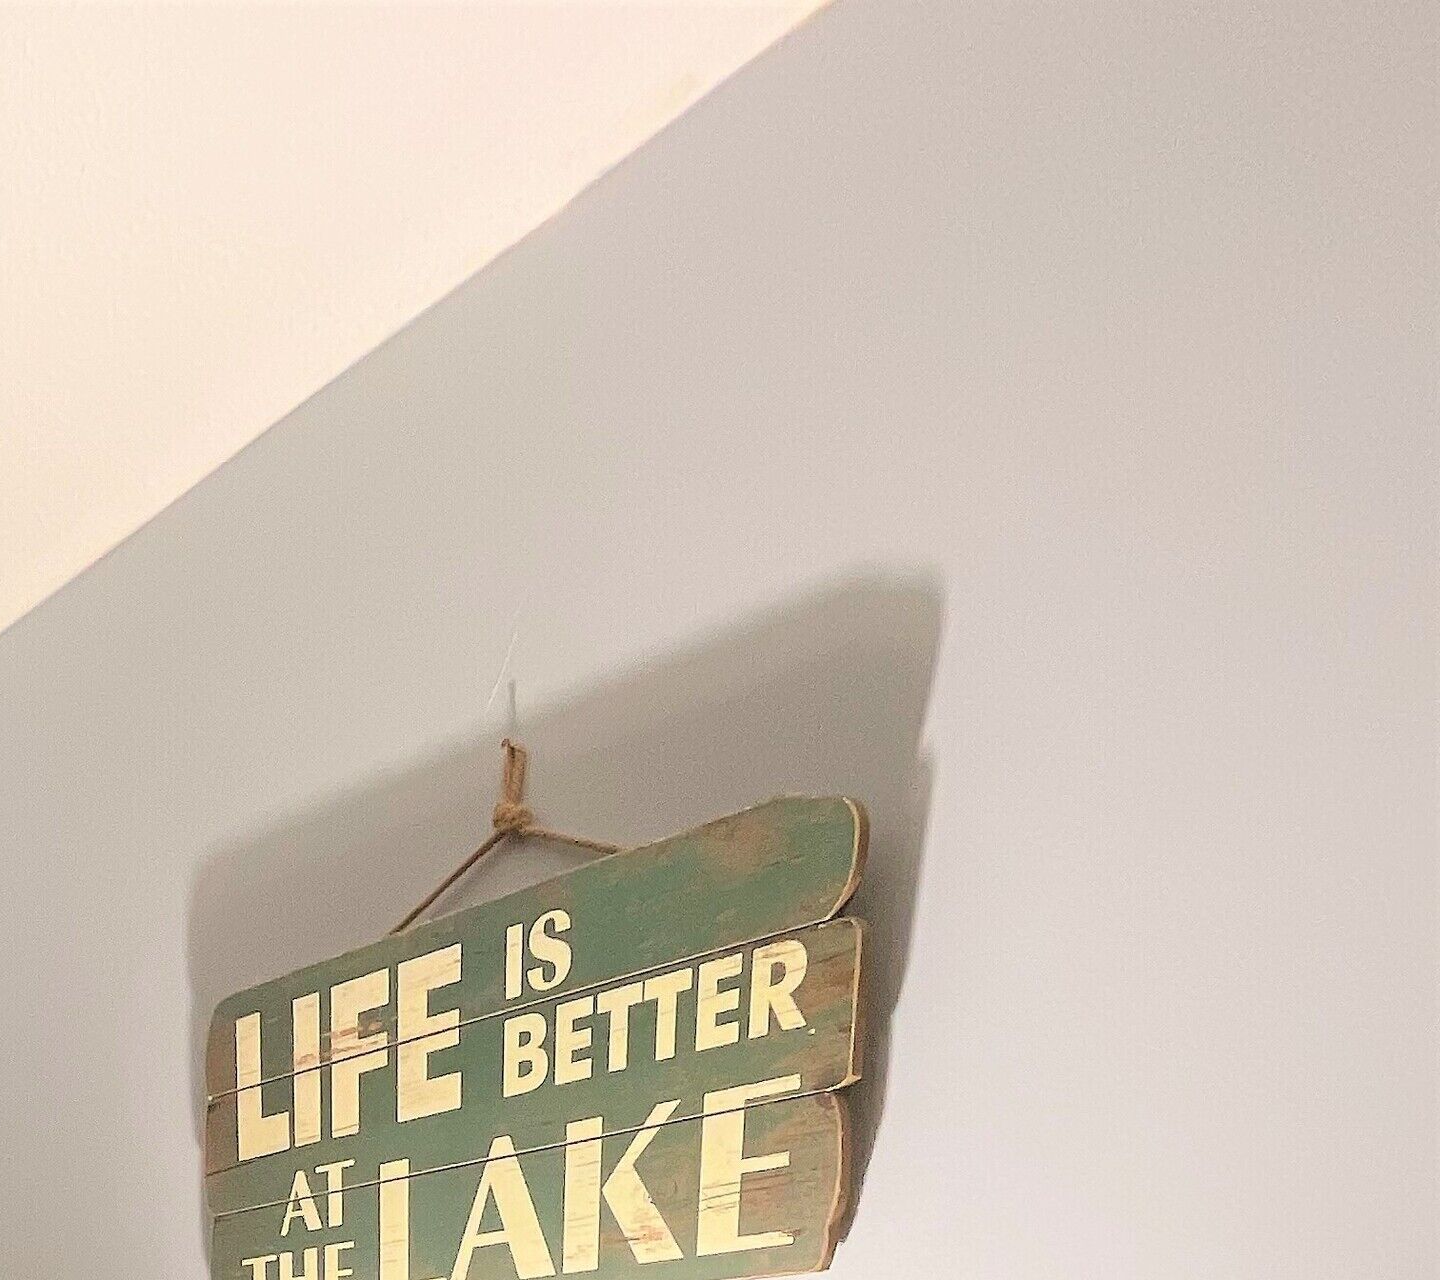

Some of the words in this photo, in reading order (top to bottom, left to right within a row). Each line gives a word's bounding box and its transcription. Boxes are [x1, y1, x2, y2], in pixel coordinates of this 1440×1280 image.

[234, 942, 462, 1162] LIFE
[504, 908, 573, 1001] IS
[503, 939, 808, 1098] BETTER
[280, 1159, 355, 1236] AT
